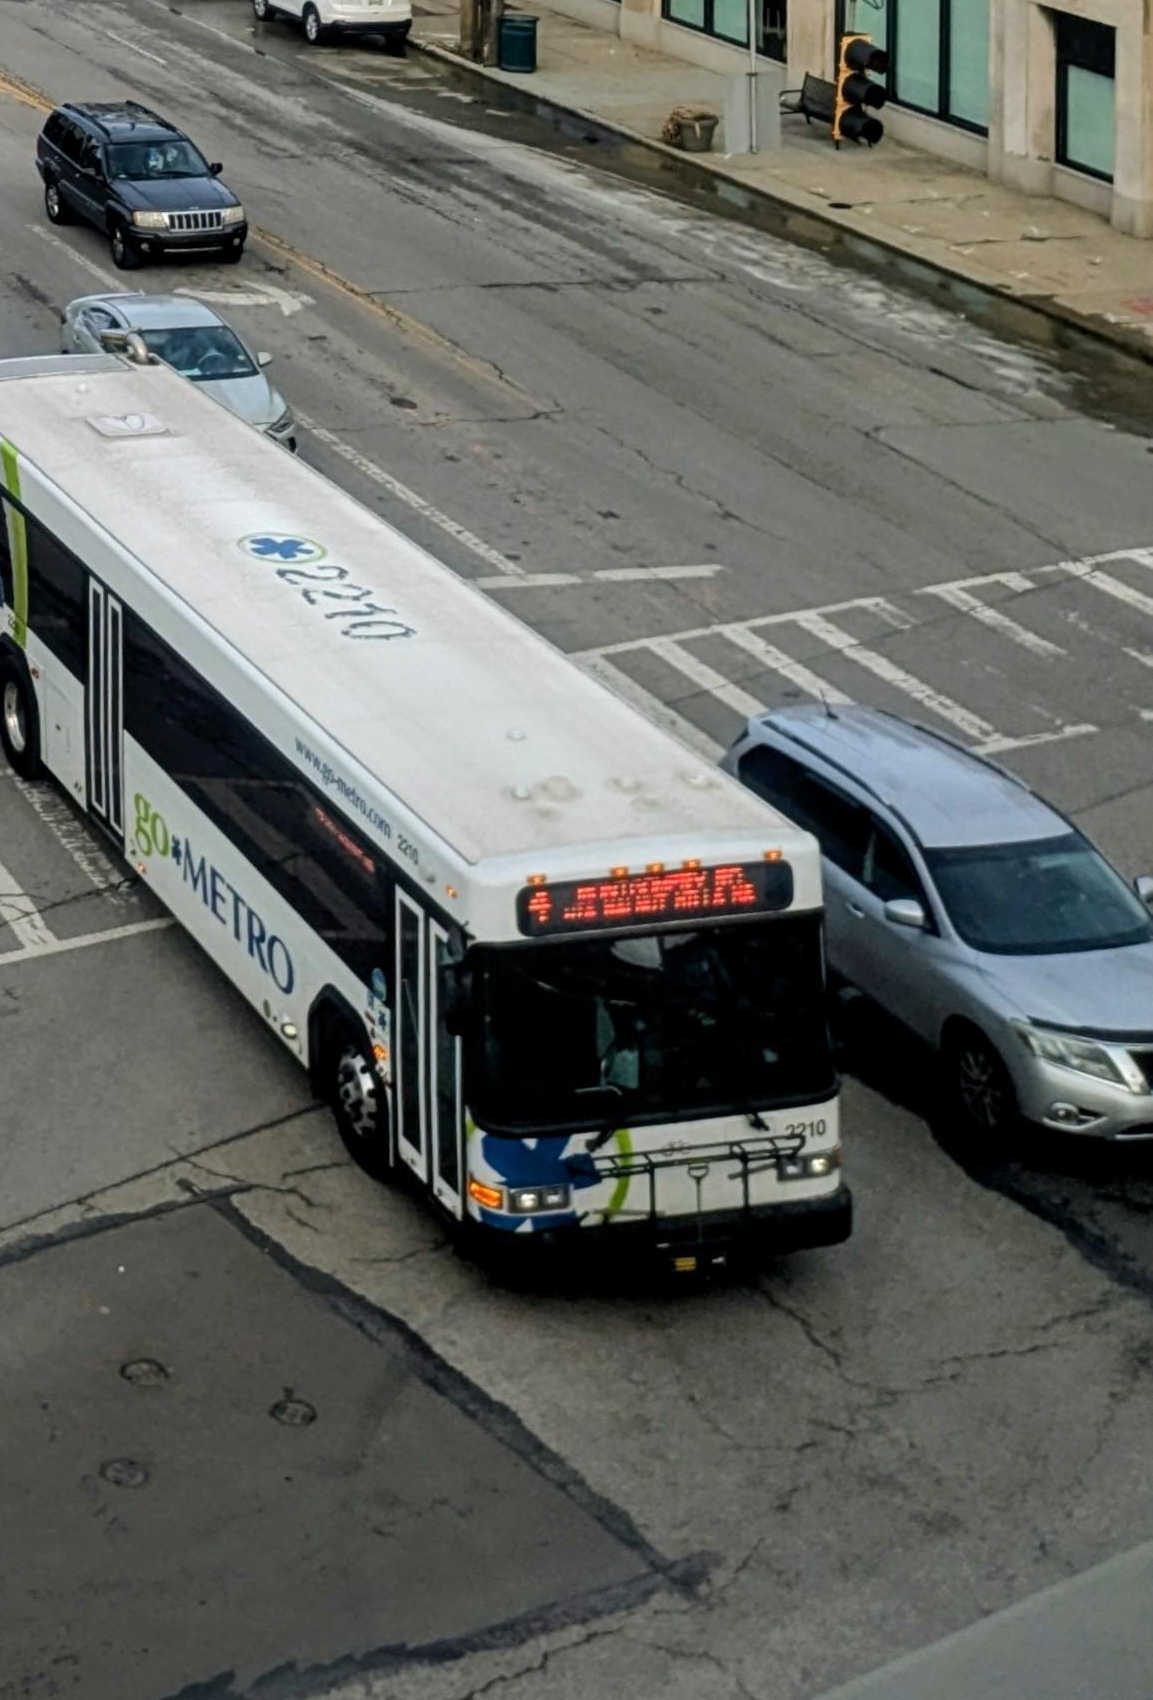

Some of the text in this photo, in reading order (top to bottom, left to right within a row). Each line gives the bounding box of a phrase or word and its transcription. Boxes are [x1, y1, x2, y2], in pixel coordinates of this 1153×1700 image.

[276, 565, 417, 641] 2210
[295, 736, 391, 839] www.go-metro.com
[134, 793, 294, 994] go METRO
[785, 1119, 827, 1137] 2210
